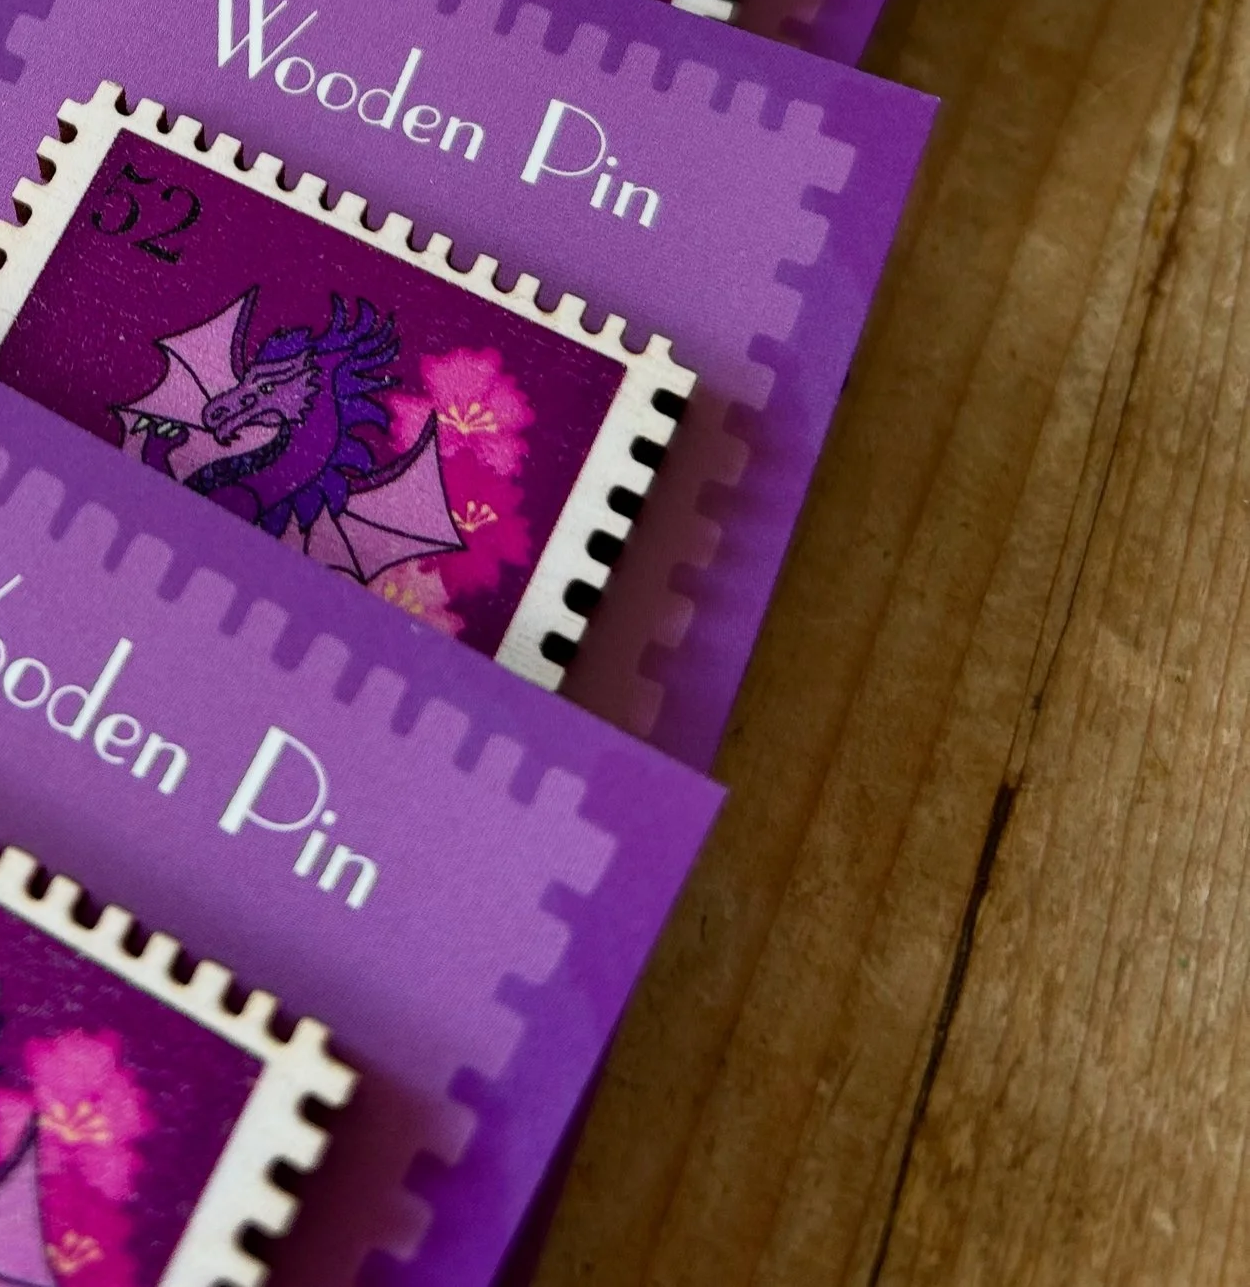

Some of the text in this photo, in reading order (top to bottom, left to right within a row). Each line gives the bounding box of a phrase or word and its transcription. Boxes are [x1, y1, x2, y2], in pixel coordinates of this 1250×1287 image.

[90, 162, 202, 266] 52
[520, 98, 661, 229] Pin
[218, 725, 382, 911] Pin
